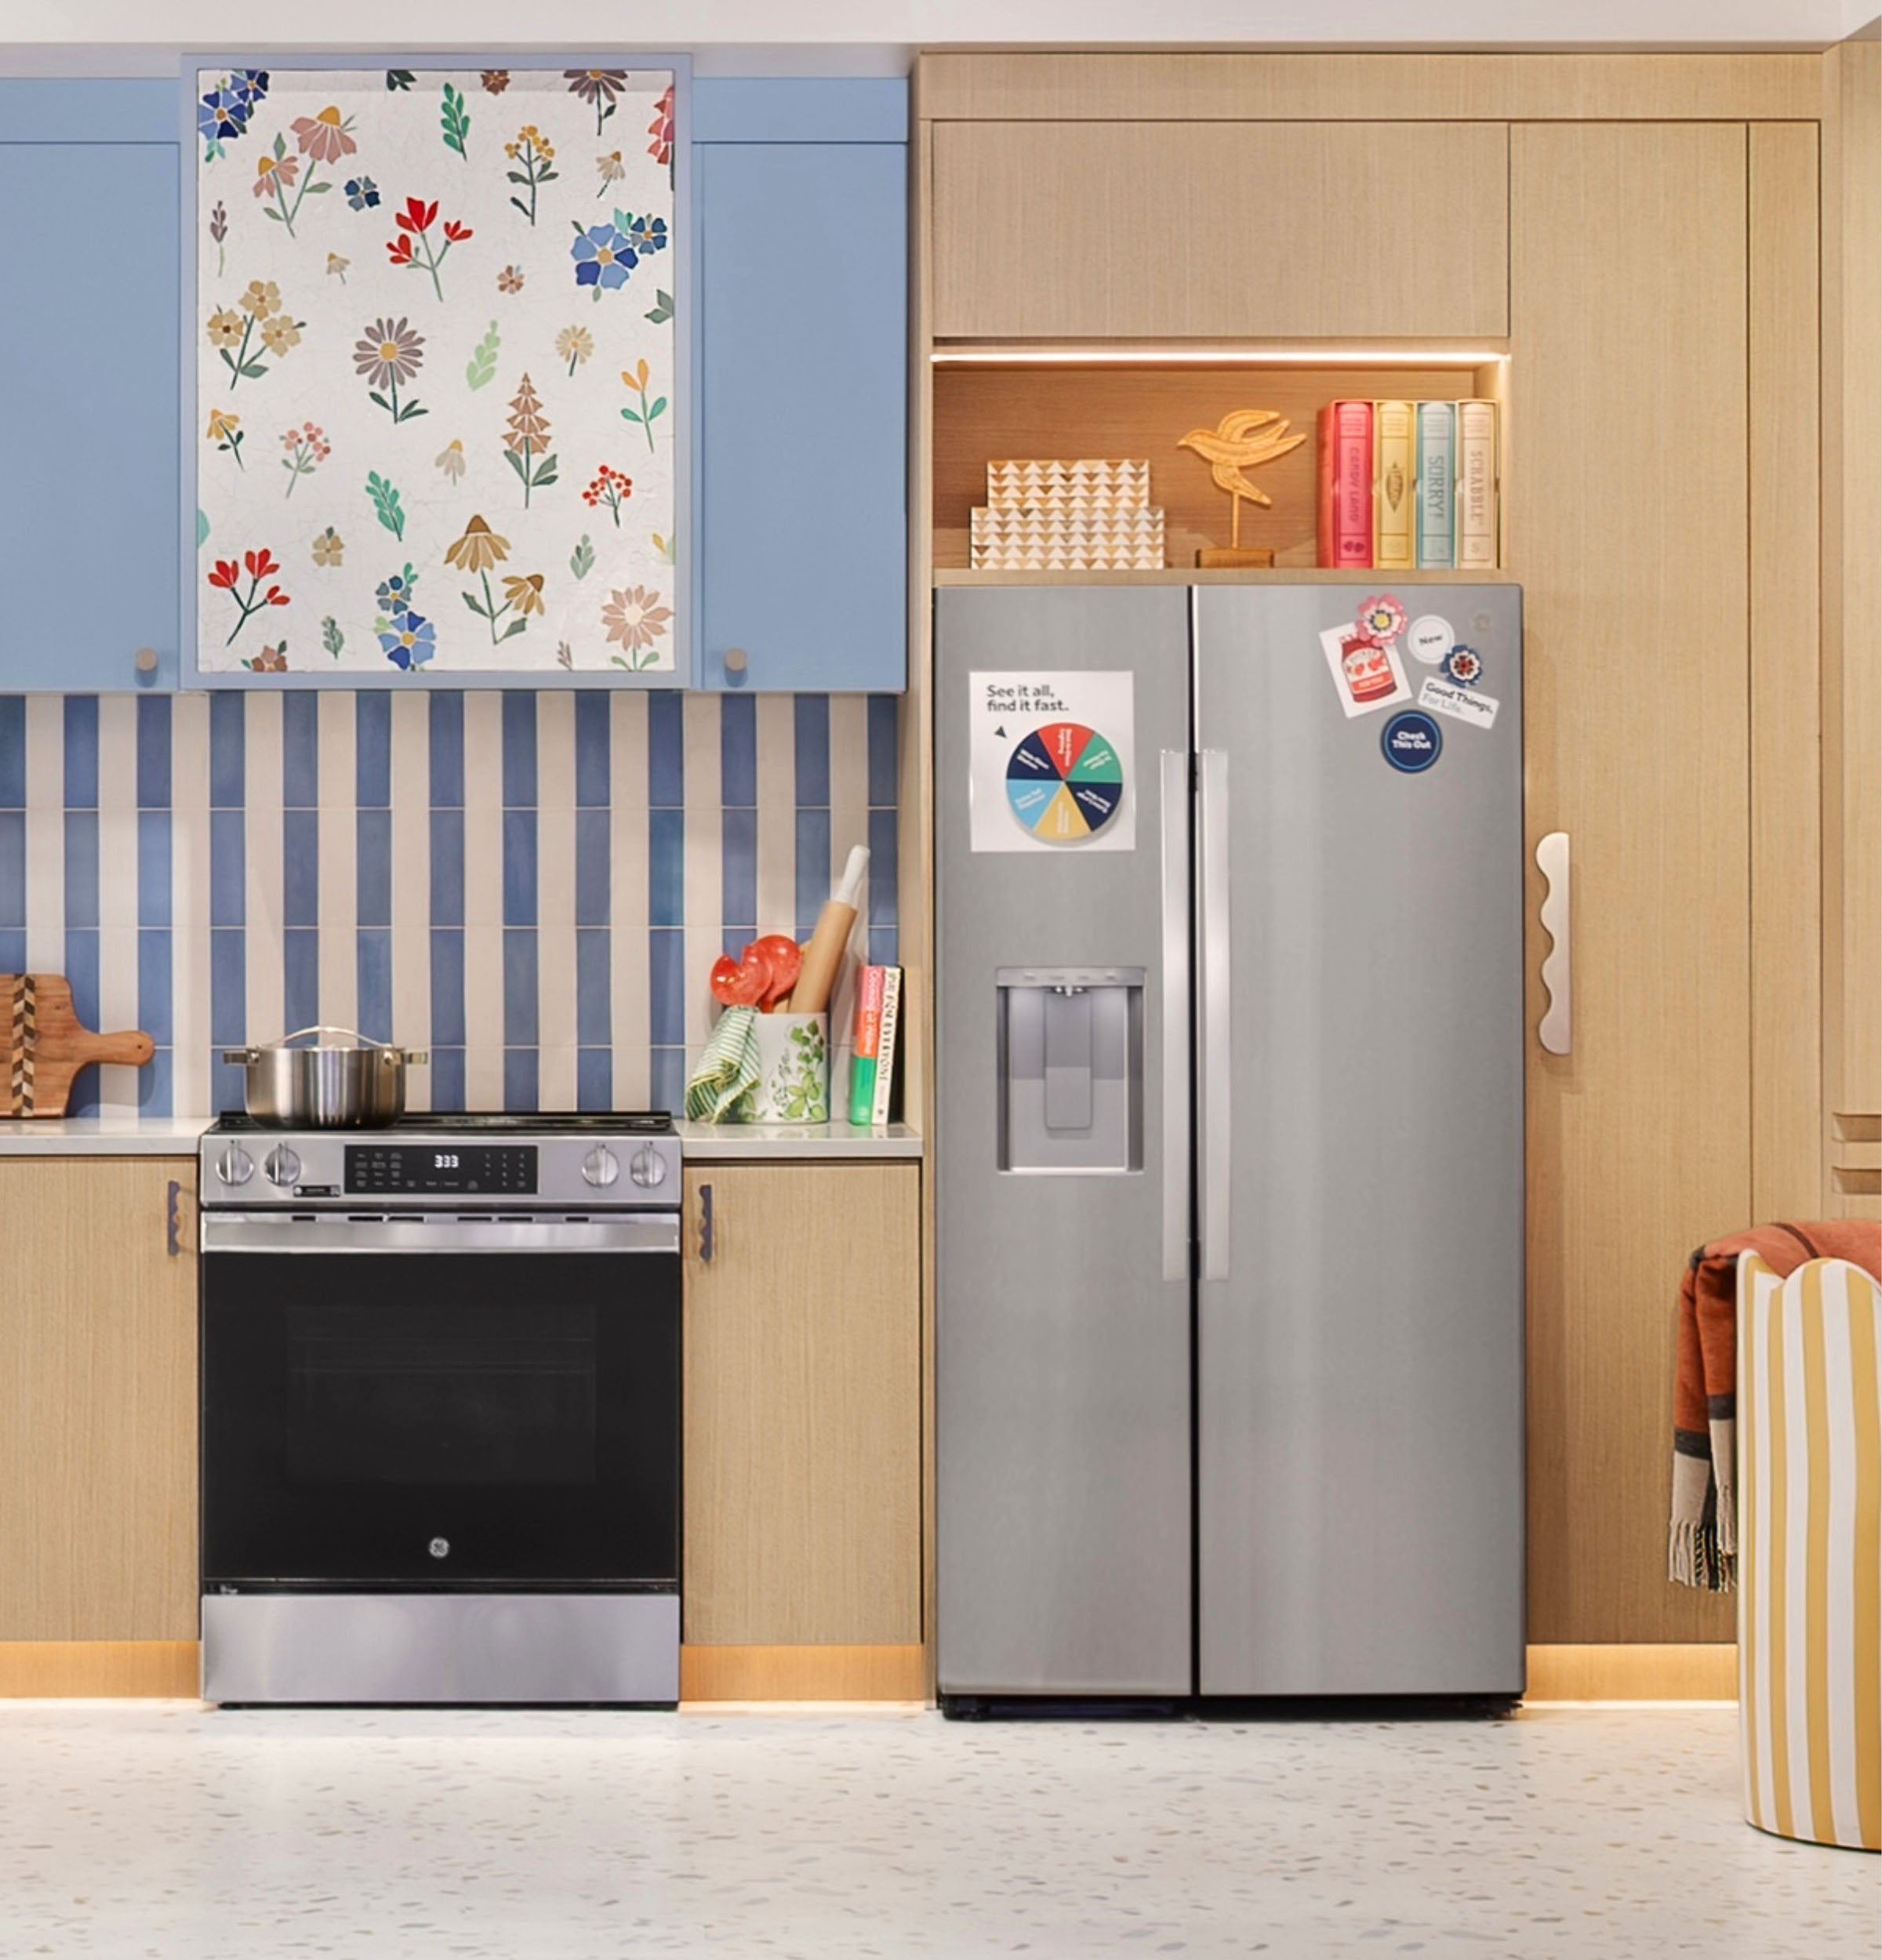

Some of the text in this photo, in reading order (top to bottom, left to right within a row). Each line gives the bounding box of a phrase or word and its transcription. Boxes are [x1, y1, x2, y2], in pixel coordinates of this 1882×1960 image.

[1419, 635, 1442, 646] New
[986, 684, 1055, 699] See it all,
[1426, 682, 1455, 699] Good
[987, 699, 1070, 711] find it fast.
[1422, 693, 1440, 706] For
[1397, 731, 1426, 740] Check
[1392, 739, 1432, 750] This Out
[434, 1155, 459, 1168] 333
